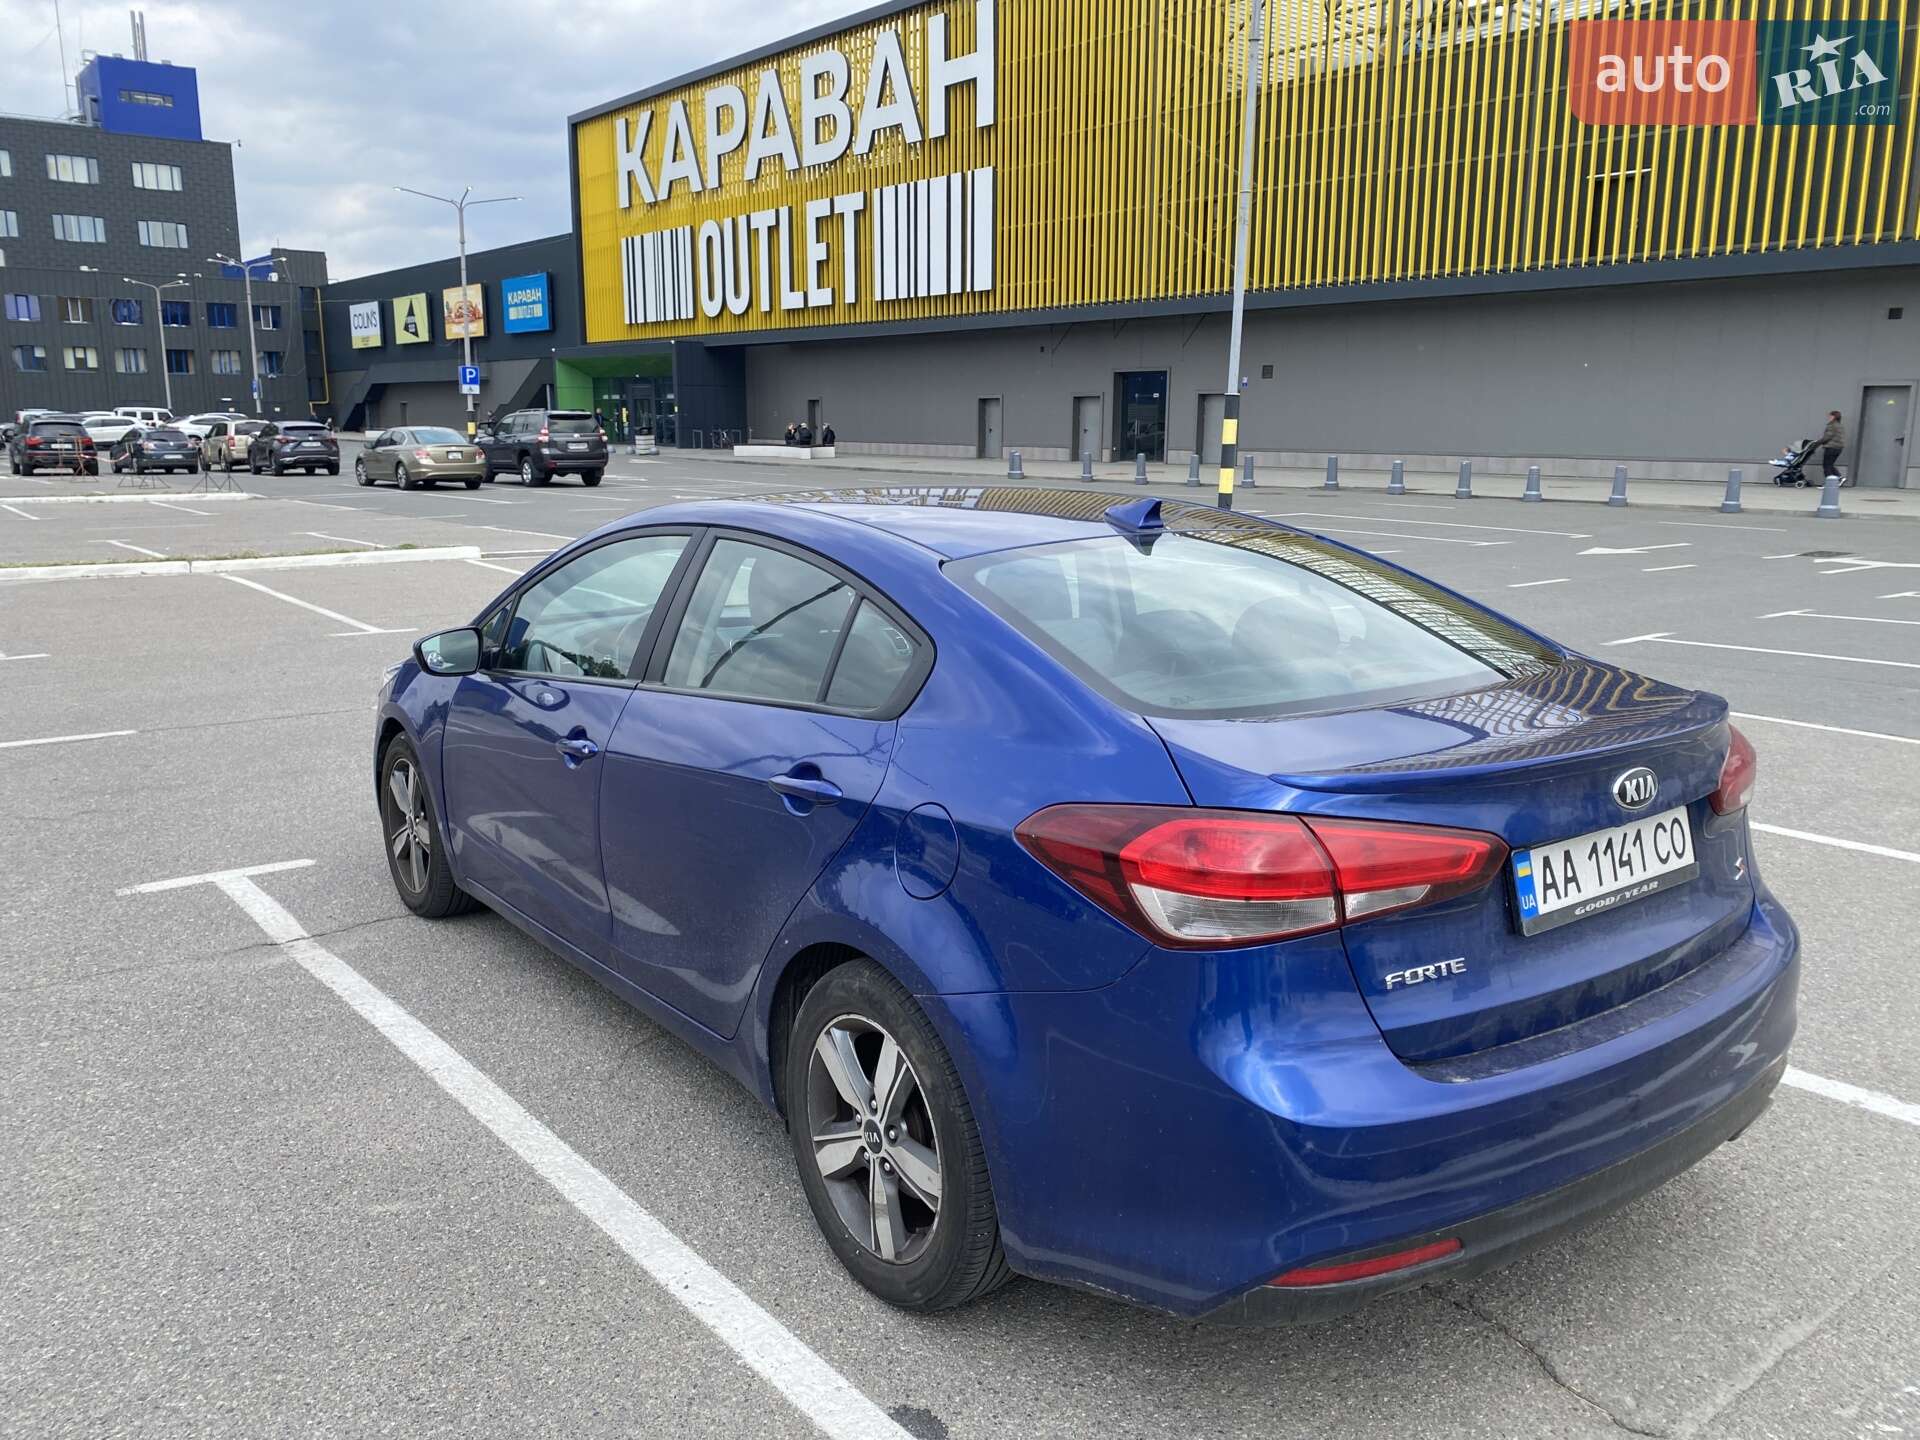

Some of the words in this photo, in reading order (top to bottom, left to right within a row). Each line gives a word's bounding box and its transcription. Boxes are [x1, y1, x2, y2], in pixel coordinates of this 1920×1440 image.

[615, 0, 994, 208] КАРАВАН
[700, 191, 864, 317] OUTLET
[507, 287, 542, 305] КАРАВАН
[466, 368, 476, 383] P
[1624, 774, 1656, 803] KIA
[1542, 849, 1582, 905] AA
[1587, 828, 1647, 888] 1141
[1653, 817, 1686, 866] CO
[1522, 894, 1537, 911] UA
[1574, 880, 1660, 916] GOODYEAR
[1384, 957, 1467, 990] FORTE
[864, 1131, 880, 1143] KIA
